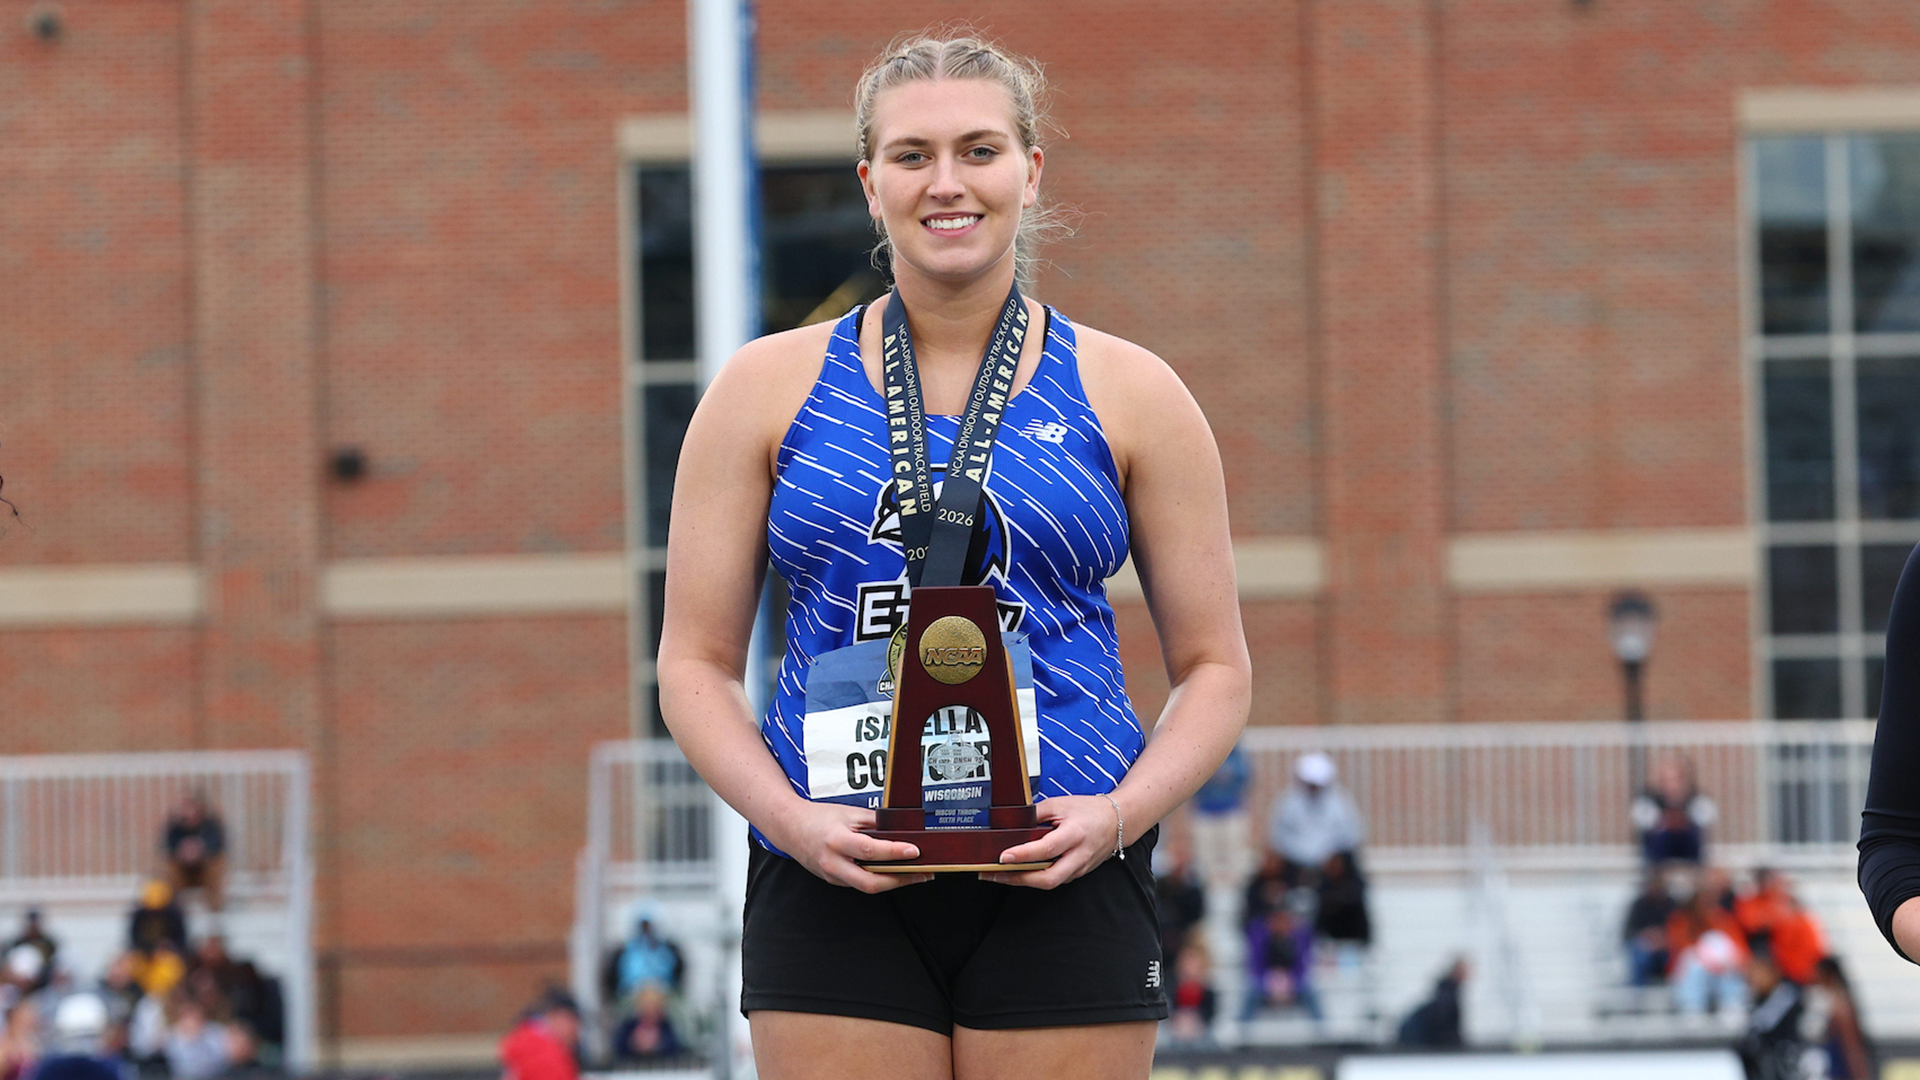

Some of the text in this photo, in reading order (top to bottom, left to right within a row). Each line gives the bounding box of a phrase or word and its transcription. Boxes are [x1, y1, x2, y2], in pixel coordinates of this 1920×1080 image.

[1003, 298, 1018, 322] FIELD
[898, 322, 909, 352] NCAA
[990, 327, 1007, 357] TRACK
[902, 349, 917, 389] DIVISION
[974, 355, 998, 401] OUTDOOR
[965, 307, 1029, 483] ALL-AMERICAN
[884, 333, 918, 517] ALL-AMERICAN
[908, 397, 923, 442] OUTDOOR
[958, 409, 978, 449] DIVISION
[913, 442, 927, 475] TRACK
[950, 449, 967, 478] NCAA
[918, 483, 932, 513] FIELD
[938, 508, 974, 527] 2026
[906, 546, 929, 562] 20
[925, 647, 983, 666] NCAA
